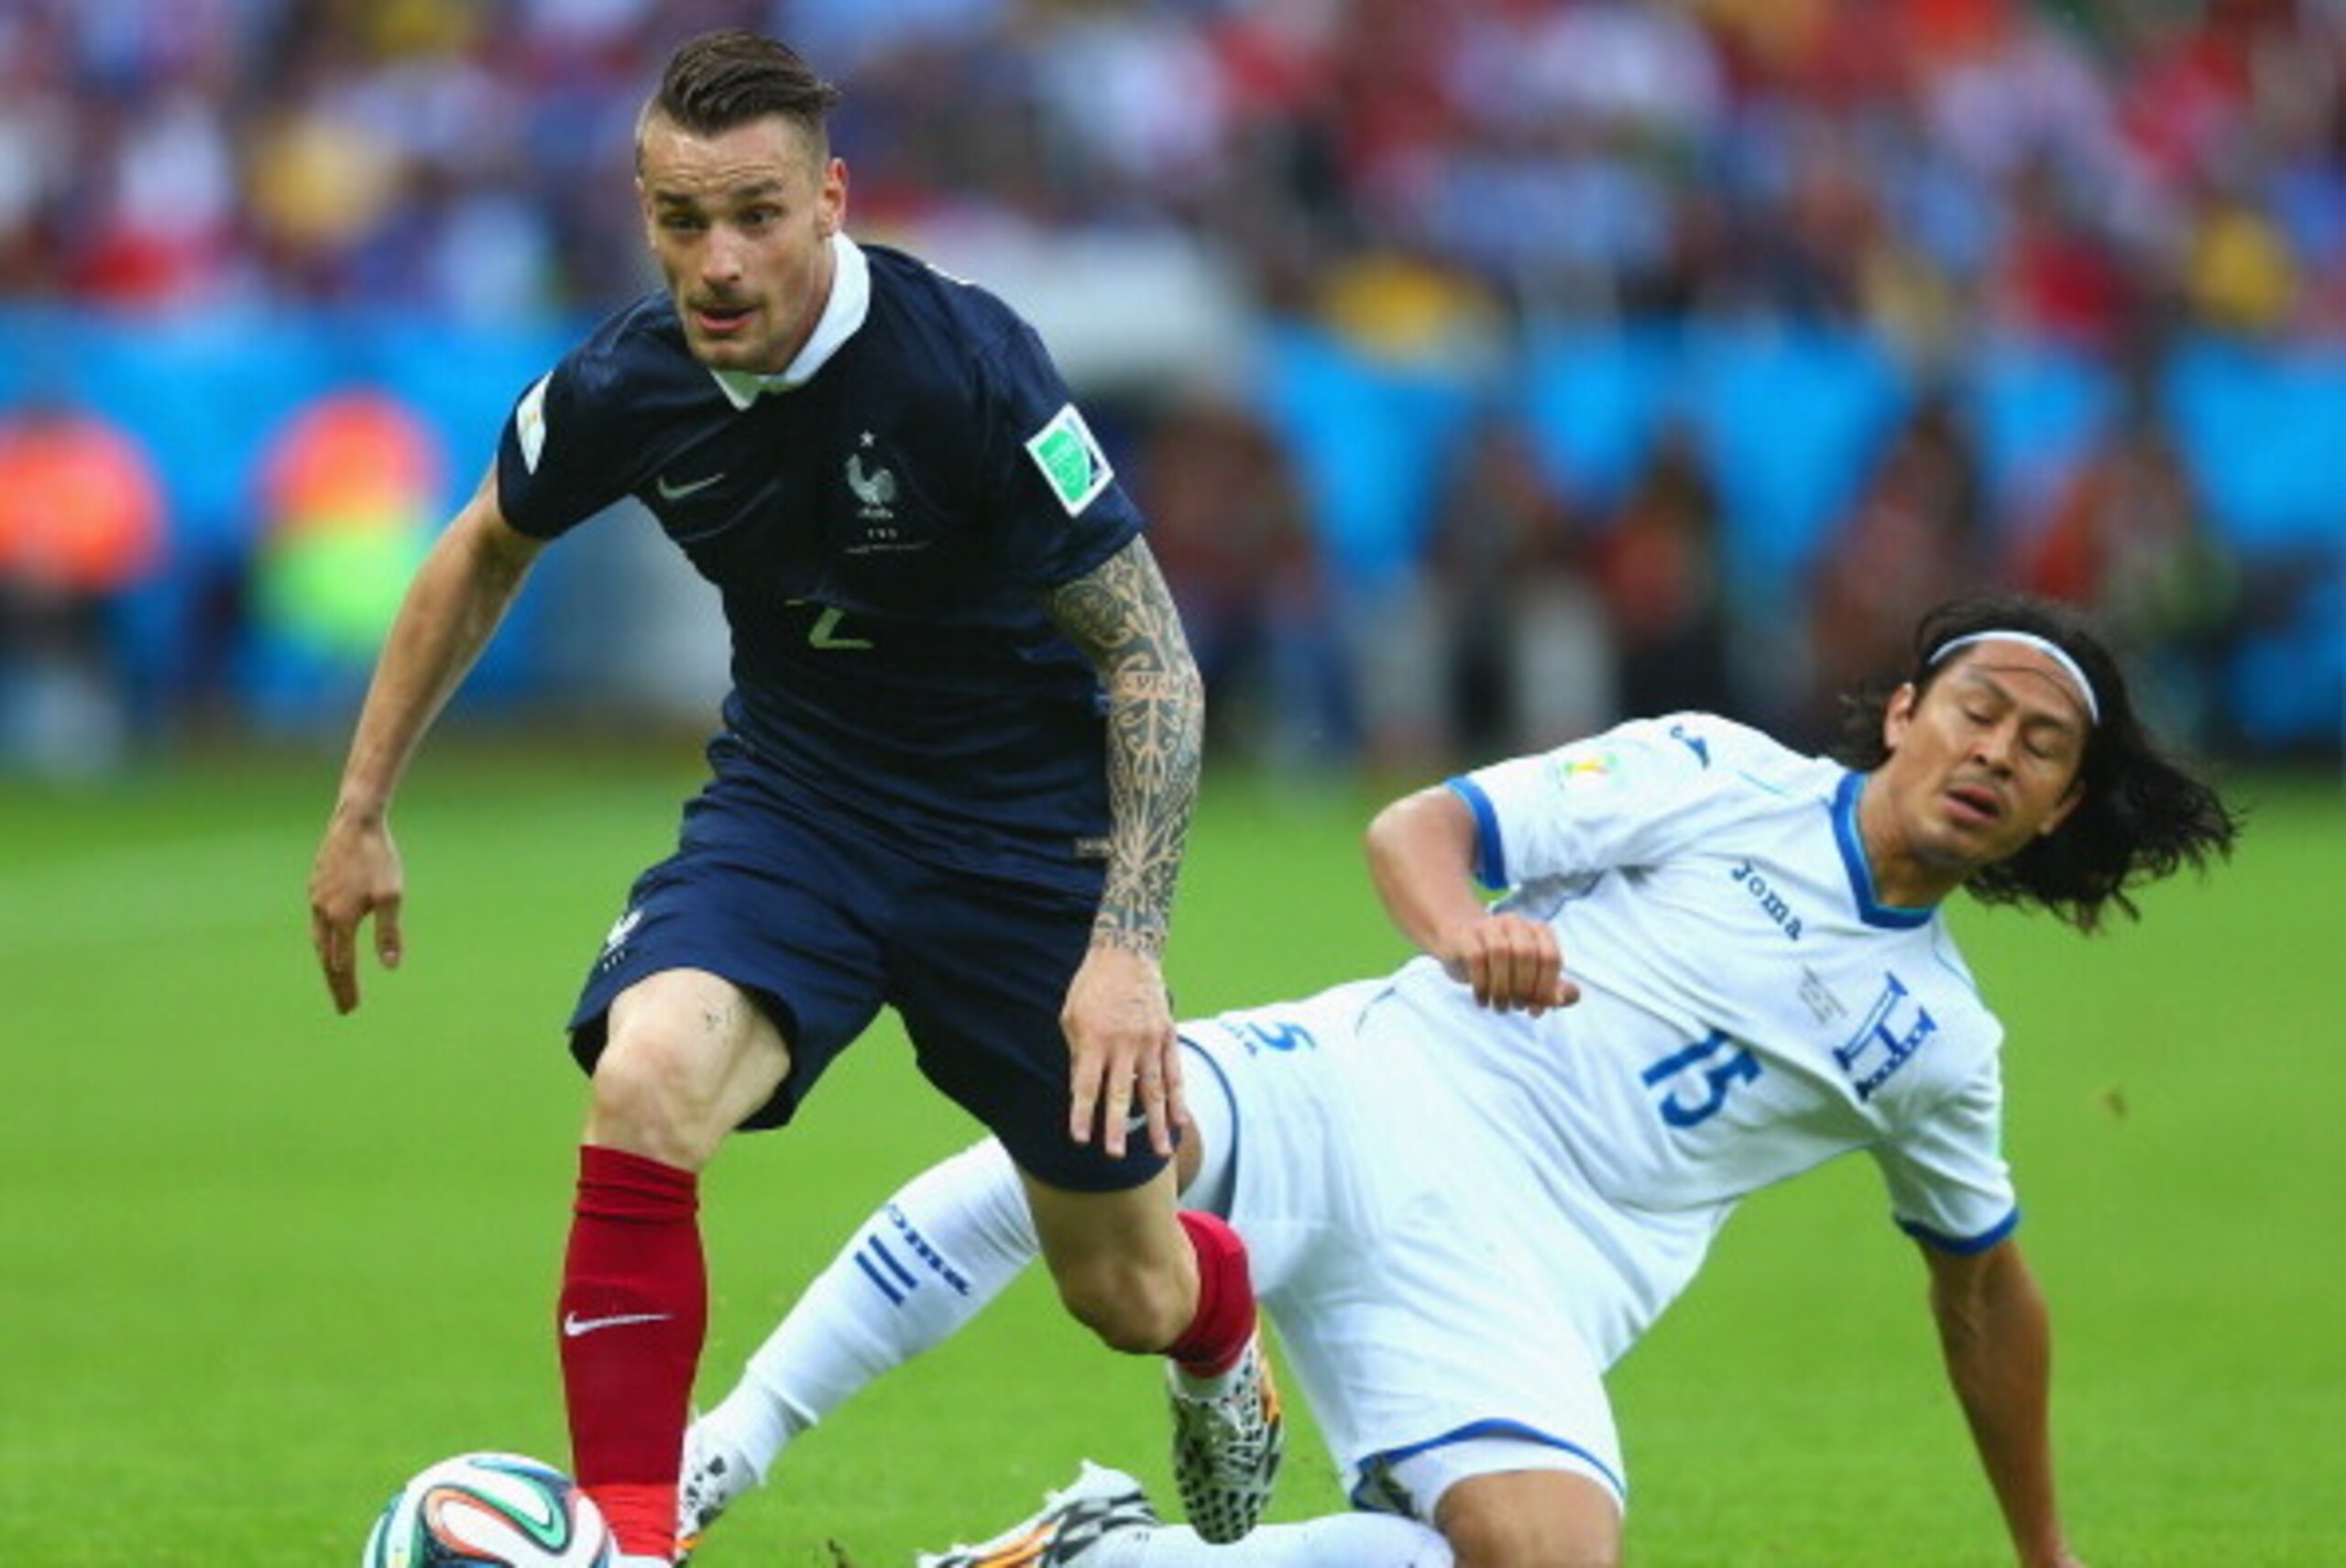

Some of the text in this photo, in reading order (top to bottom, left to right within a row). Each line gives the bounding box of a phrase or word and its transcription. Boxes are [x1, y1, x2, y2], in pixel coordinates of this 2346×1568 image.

[784, 598, 874, 650] 2
[1729, 858, 1803, 942] Joma
[1641, 1027, 1763, 1129] 15
